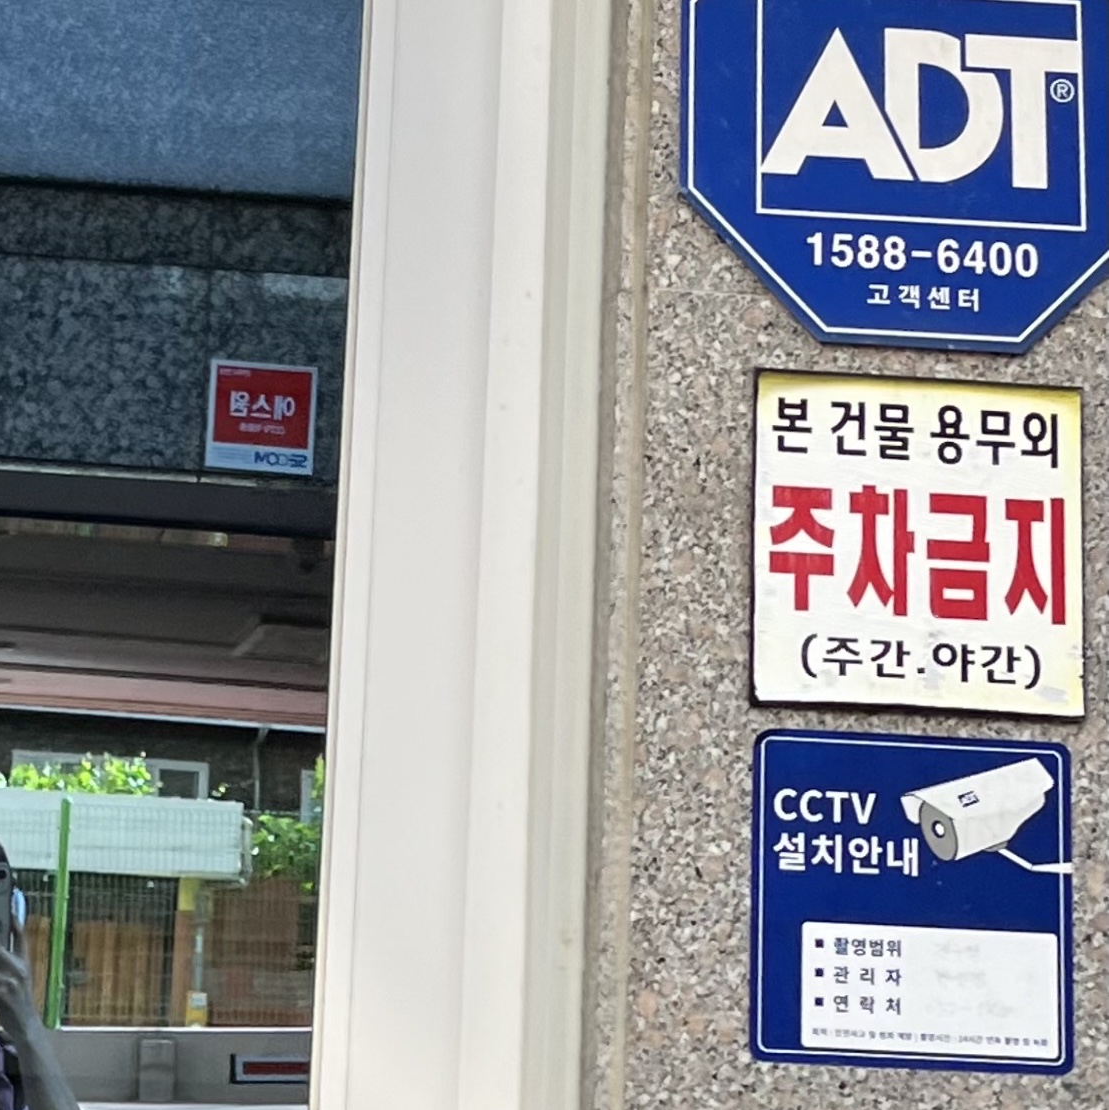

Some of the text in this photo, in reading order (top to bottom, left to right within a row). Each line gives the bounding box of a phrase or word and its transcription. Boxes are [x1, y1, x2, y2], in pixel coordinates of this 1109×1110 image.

[761, 27, 1079, 190] ADT
[806, 232, 1039, 278] 1588-6400
[866, 284, 981, 313] 고객센터
[772, 397, 1059, 469] 본 건물 용무외
[769, 484, 1067, 626] 주차금지
[773, 788, 877, 825] CCTV
[773, 832, 920, 877] 설치안내
